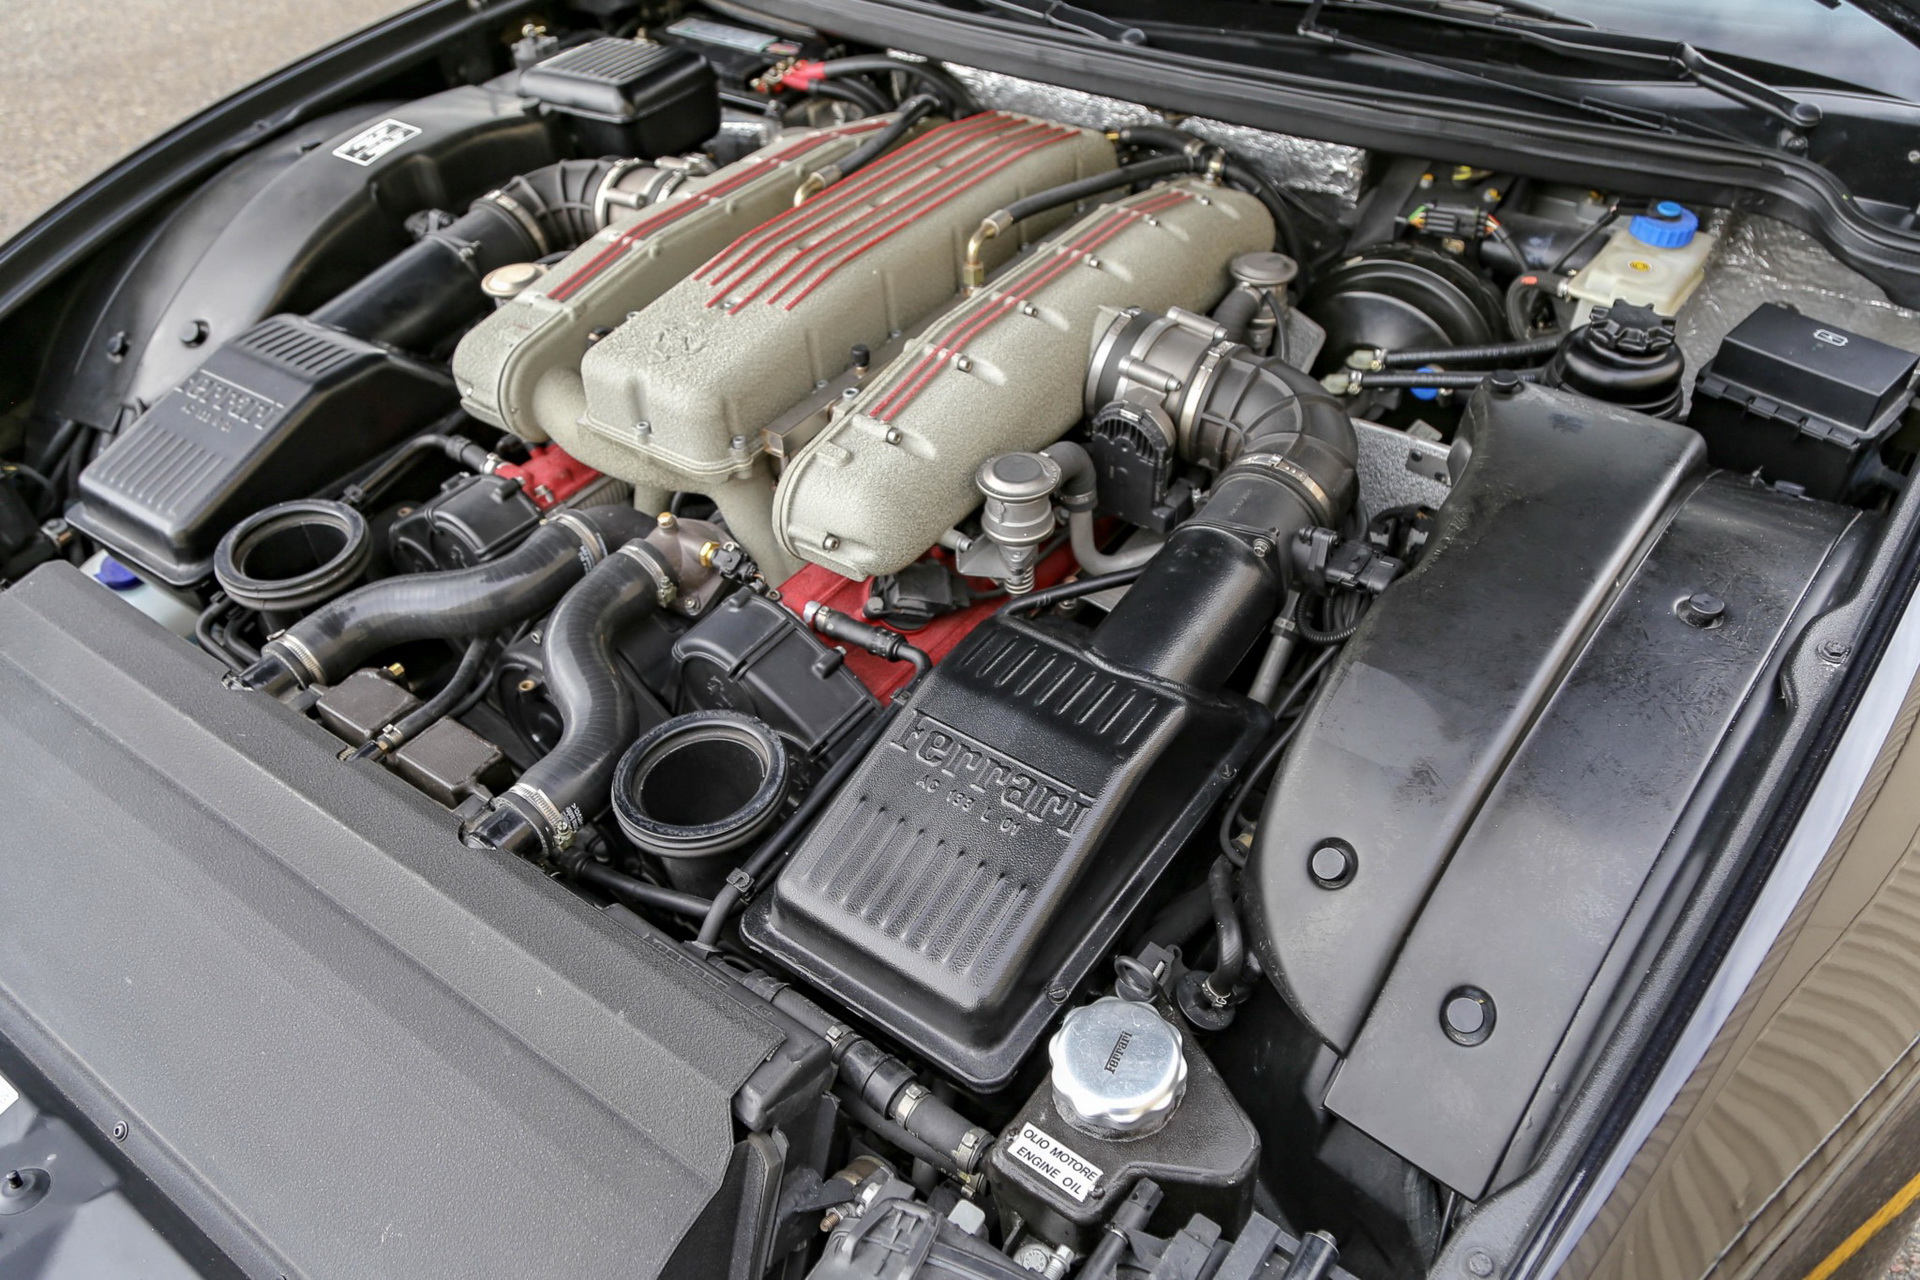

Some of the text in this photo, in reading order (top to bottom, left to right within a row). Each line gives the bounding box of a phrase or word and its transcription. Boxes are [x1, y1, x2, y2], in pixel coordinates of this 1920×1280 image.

[174, 369, 285, 430] Ferrari
[891, 708, 1100, 838] Ferrari
[1103, 1031, 1133, 1075] Ferrari
[1016, 1146, 1082, 1195] ENGINE OIL
[1023, 1129, 1098, 1181] OLIO MOTORE
